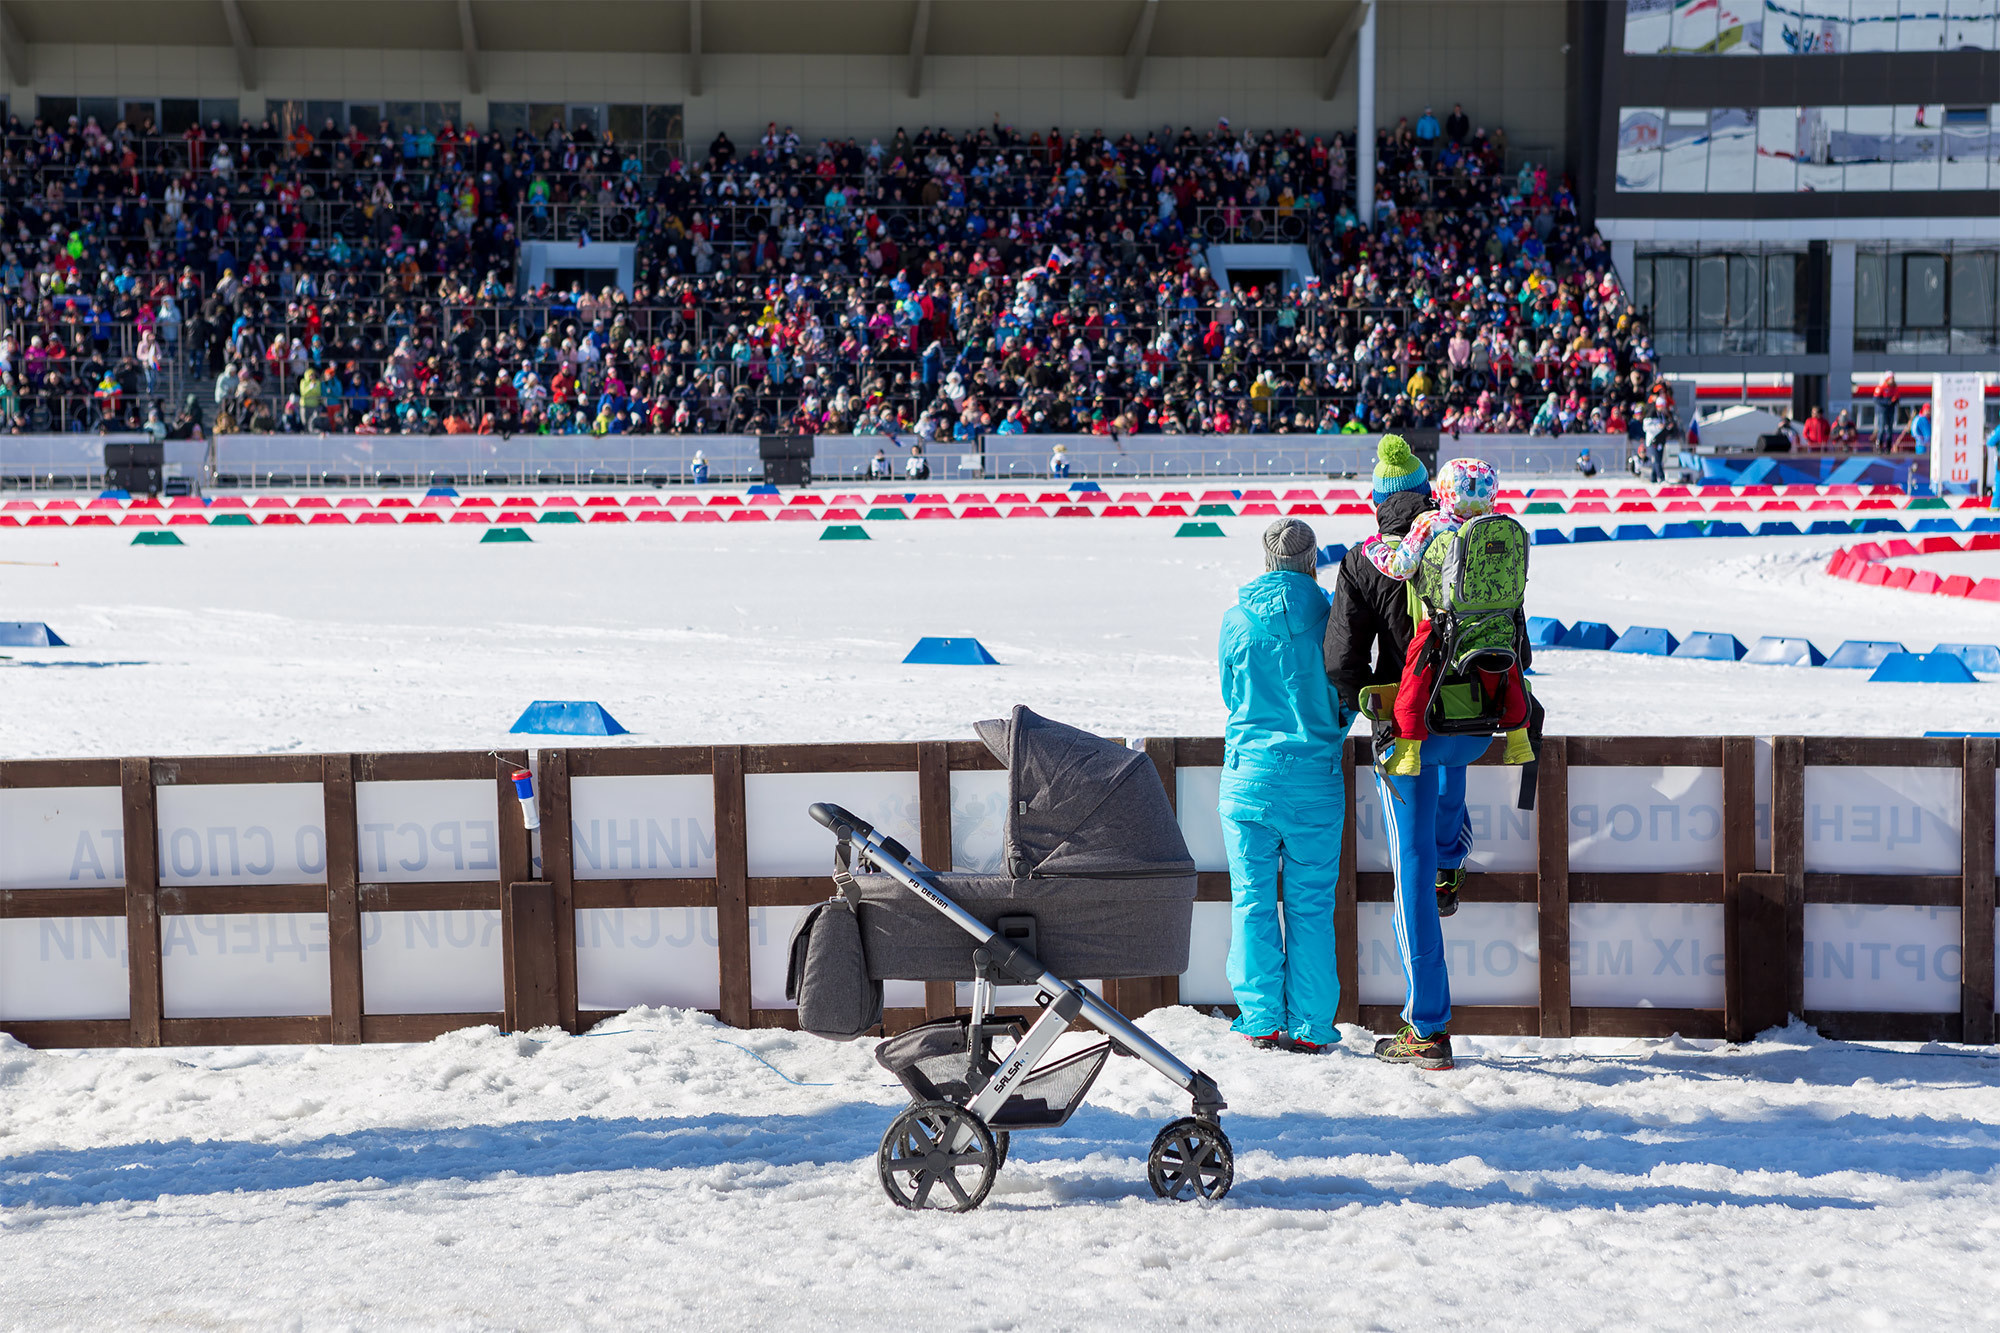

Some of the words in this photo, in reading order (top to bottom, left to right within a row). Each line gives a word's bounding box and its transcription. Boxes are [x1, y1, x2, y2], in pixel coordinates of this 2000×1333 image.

[1952, 398, 1968, 482] ФИНИШ
[908, 878, 920, 889] FD
[921, 887, 949, 909] DESIGN
